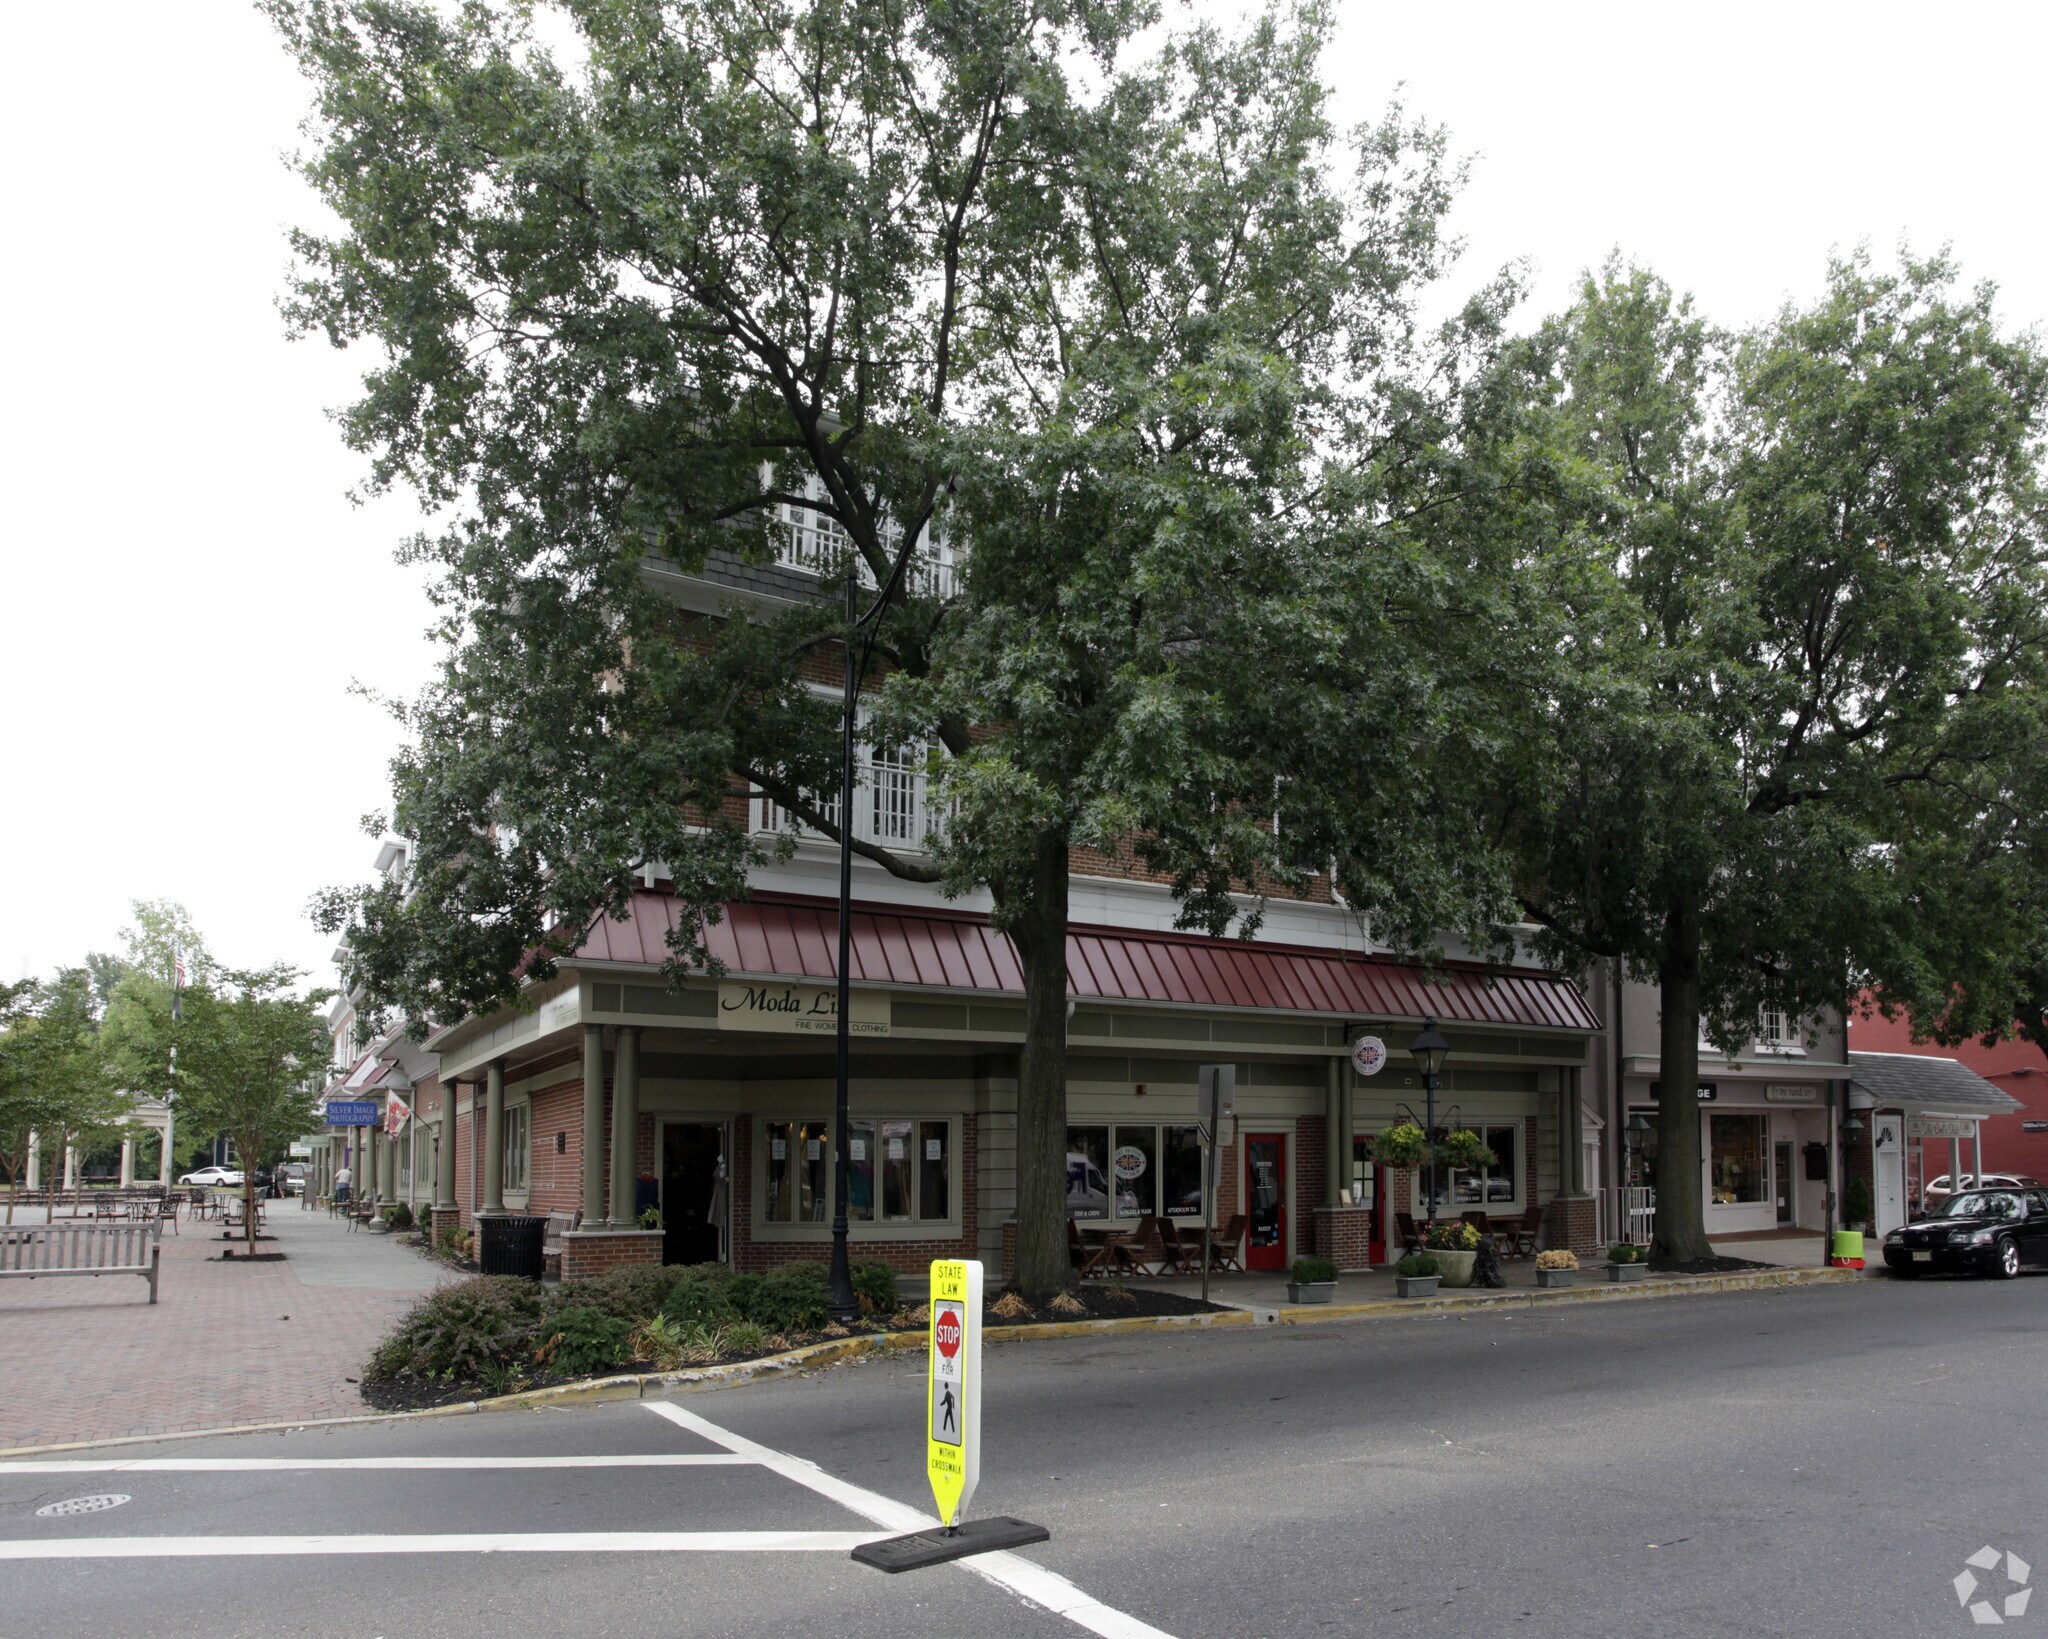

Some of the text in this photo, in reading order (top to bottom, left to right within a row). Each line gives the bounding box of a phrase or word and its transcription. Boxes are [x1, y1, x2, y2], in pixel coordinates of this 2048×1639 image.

[721, 986, 845, 1016] Moda Li
[795, 1021, 888, 1033] FINE WOME CLOTHING
[329, 1104, 376, 1115] SILVER IMAGE
[329, 1114, 375, 1123] PHOTOGRAPHY
[938, 1266, 962, 1280] STATE
[941, 1282, 958, 1296] LAW
[937, 1325, 960, 1345] STOP
[941, 1364, 954, 1376] FOR
[939, 1447, 956, 1459] WITHIN
[931, 1458, 962, 1475] CROSSWALK
